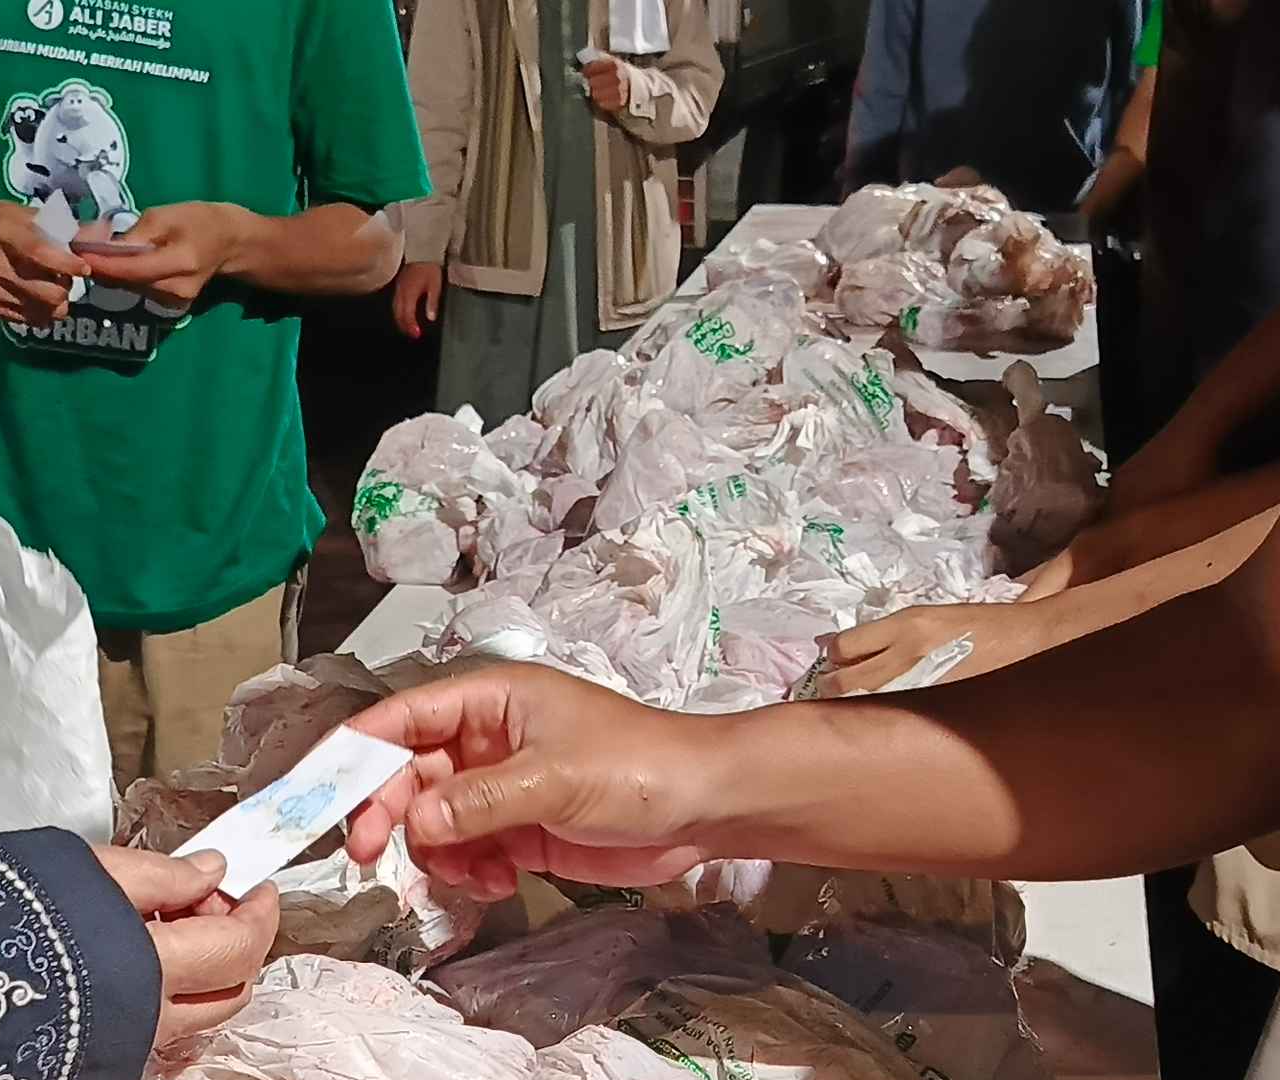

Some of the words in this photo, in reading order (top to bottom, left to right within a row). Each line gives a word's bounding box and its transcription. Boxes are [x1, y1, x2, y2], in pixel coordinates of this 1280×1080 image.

[68, 6, 104, 26] ALI
[108, 10, 172, 37] JABER
[130, 5, 174, 21] SYEKH
[89, 52, 143, 74] BERKAH
[142, 62, 210, 84] MELIMPAH
